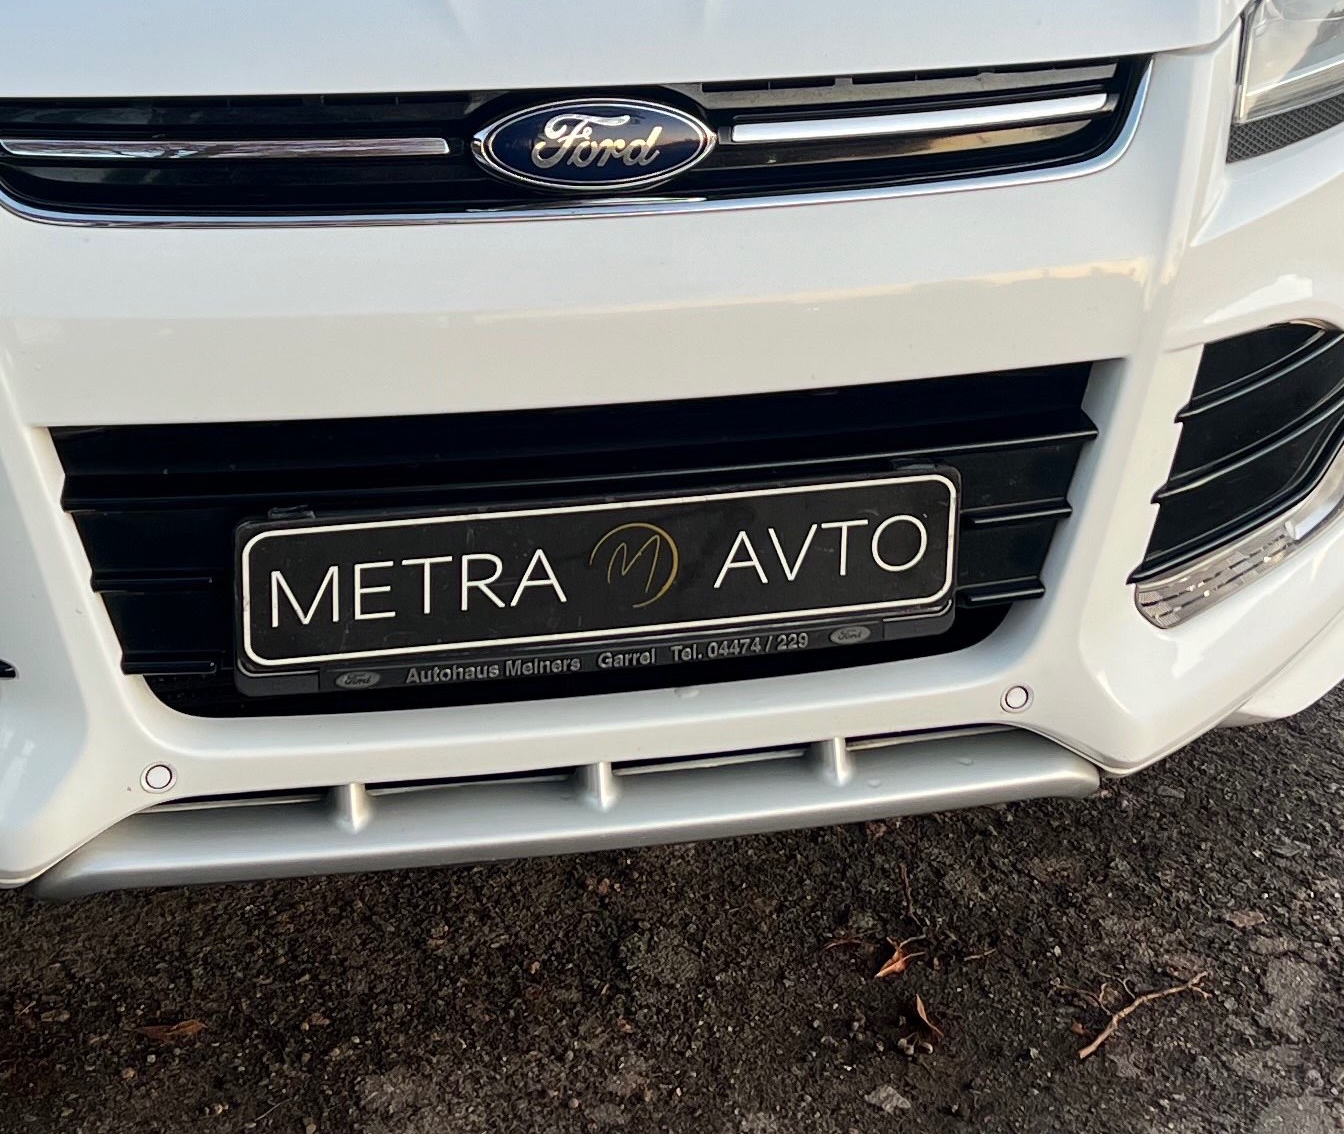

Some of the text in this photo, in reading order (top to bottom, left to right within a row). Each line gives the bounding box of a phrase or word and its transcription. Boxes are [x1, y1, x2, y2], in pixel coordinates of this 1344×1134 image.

[531, 113, 663, 169] Ford
[270, 548, 568, 628] METRA
[713, 514, 928, 589] AVTO
[406, 664, 500, 684] Autohaus
[505, 657, 581, 677] Meiners
[598, 648, 656, 669] Garrel
[670, 644, 703, 663] Tel.
[708, 636, 761, 659] 04474
[777, 632, 809, 651] 229
